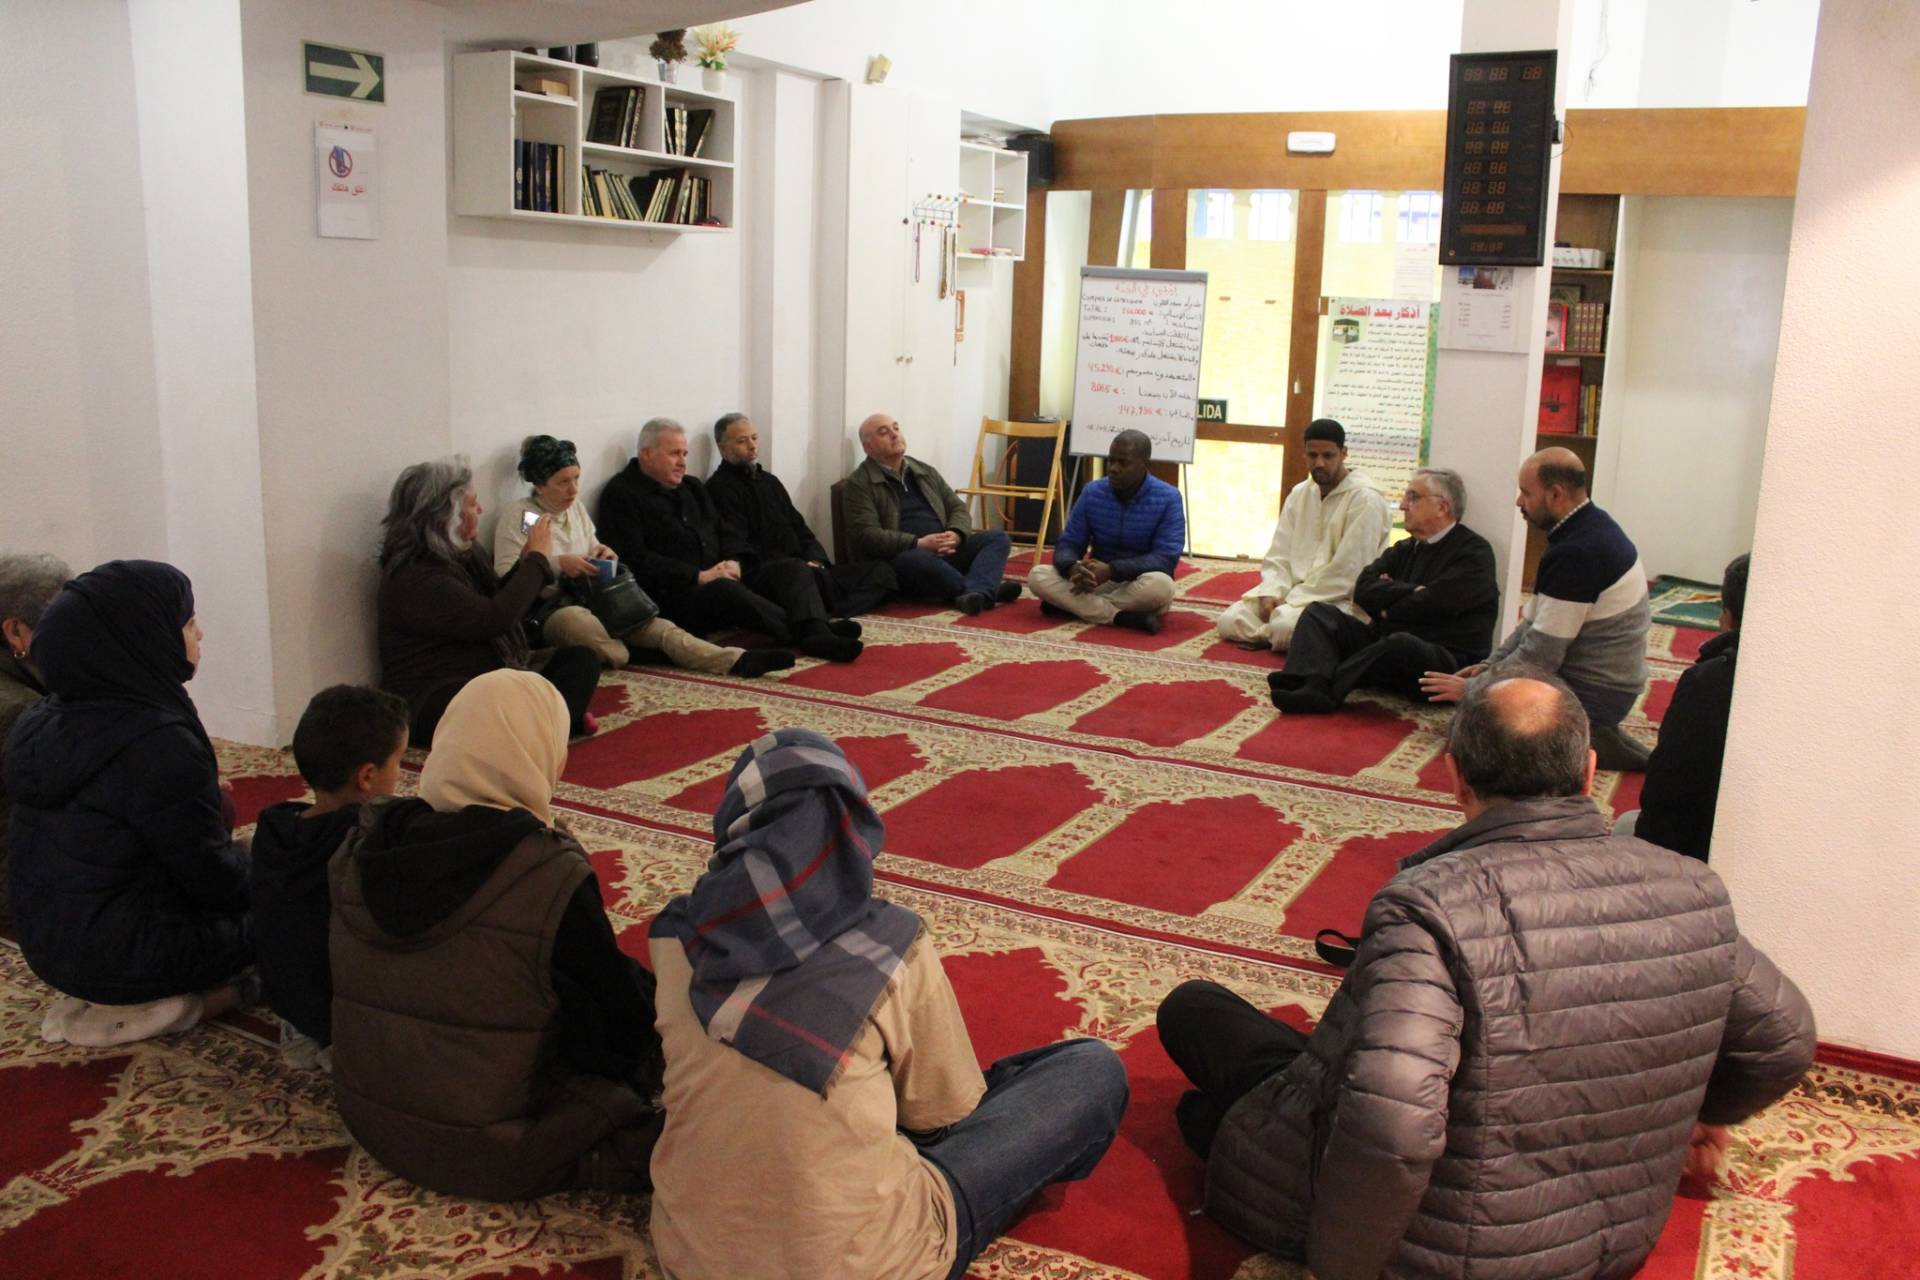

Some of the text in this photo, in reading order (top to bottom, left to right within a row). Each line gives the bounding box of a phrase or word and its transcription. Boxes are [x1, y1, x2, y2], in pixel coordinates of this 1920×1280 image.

[1339, 304, 1420, 320] أذكار بعد الصلاة
